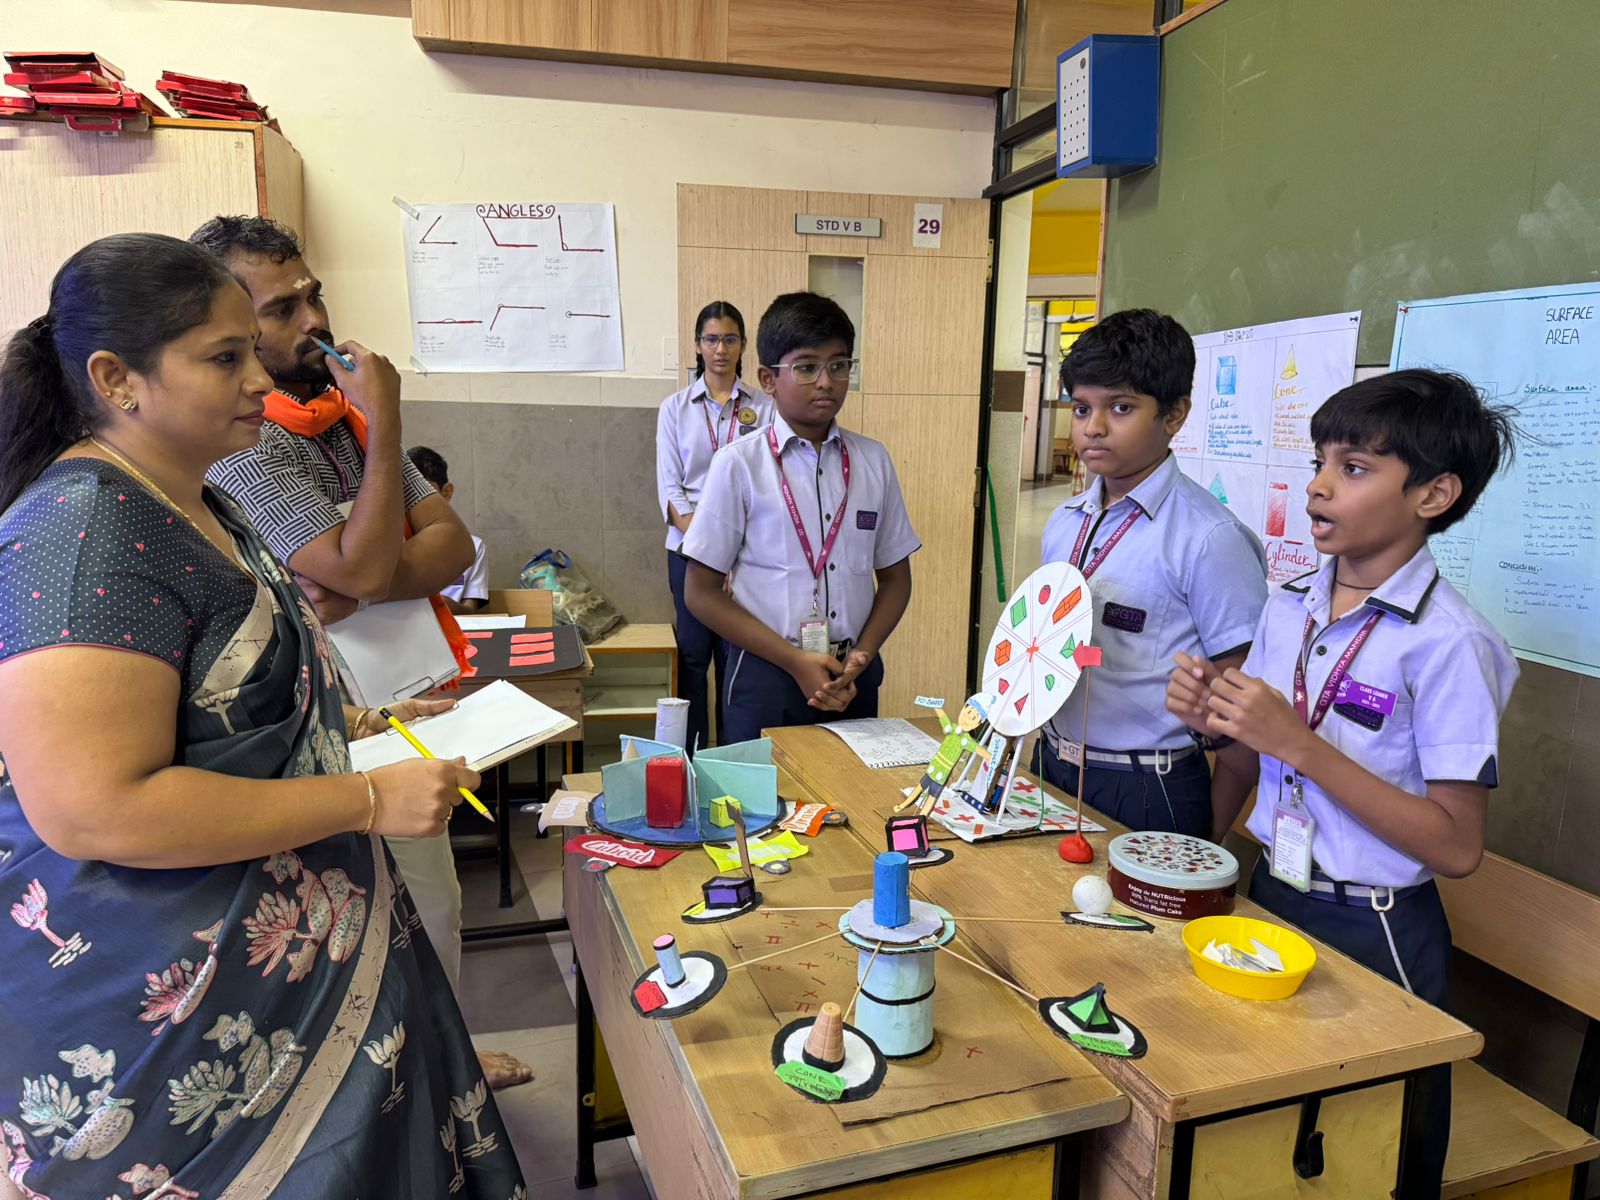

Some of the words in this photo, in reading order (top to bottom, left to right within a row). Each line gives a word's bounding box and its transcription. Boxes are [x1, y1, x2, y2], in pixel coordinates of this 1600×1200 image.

[486, 203, 544, 218] ANGLES
[816, 219, 839, 231] STD
[843, 221, 850, 231] V
[854, 222, 862, 232] B
[917, 218, 941, 235] 29
[1545, 306, 1595, 322] SURFACE
[1545, 328, 1580, 345] AREA
[1266, 541, 1310, 568] Cylinder
[1319, 690, 1332, 706] GTA
[1328, 660, 1346, 687] VIDHYA
[1359, 686, 1373, 695] CLASS
[1128, 883, 1143, 894] Enjoy
[1150, 904, 1166, 912] Plum
[795, 1067, 827, 1084] CONE
